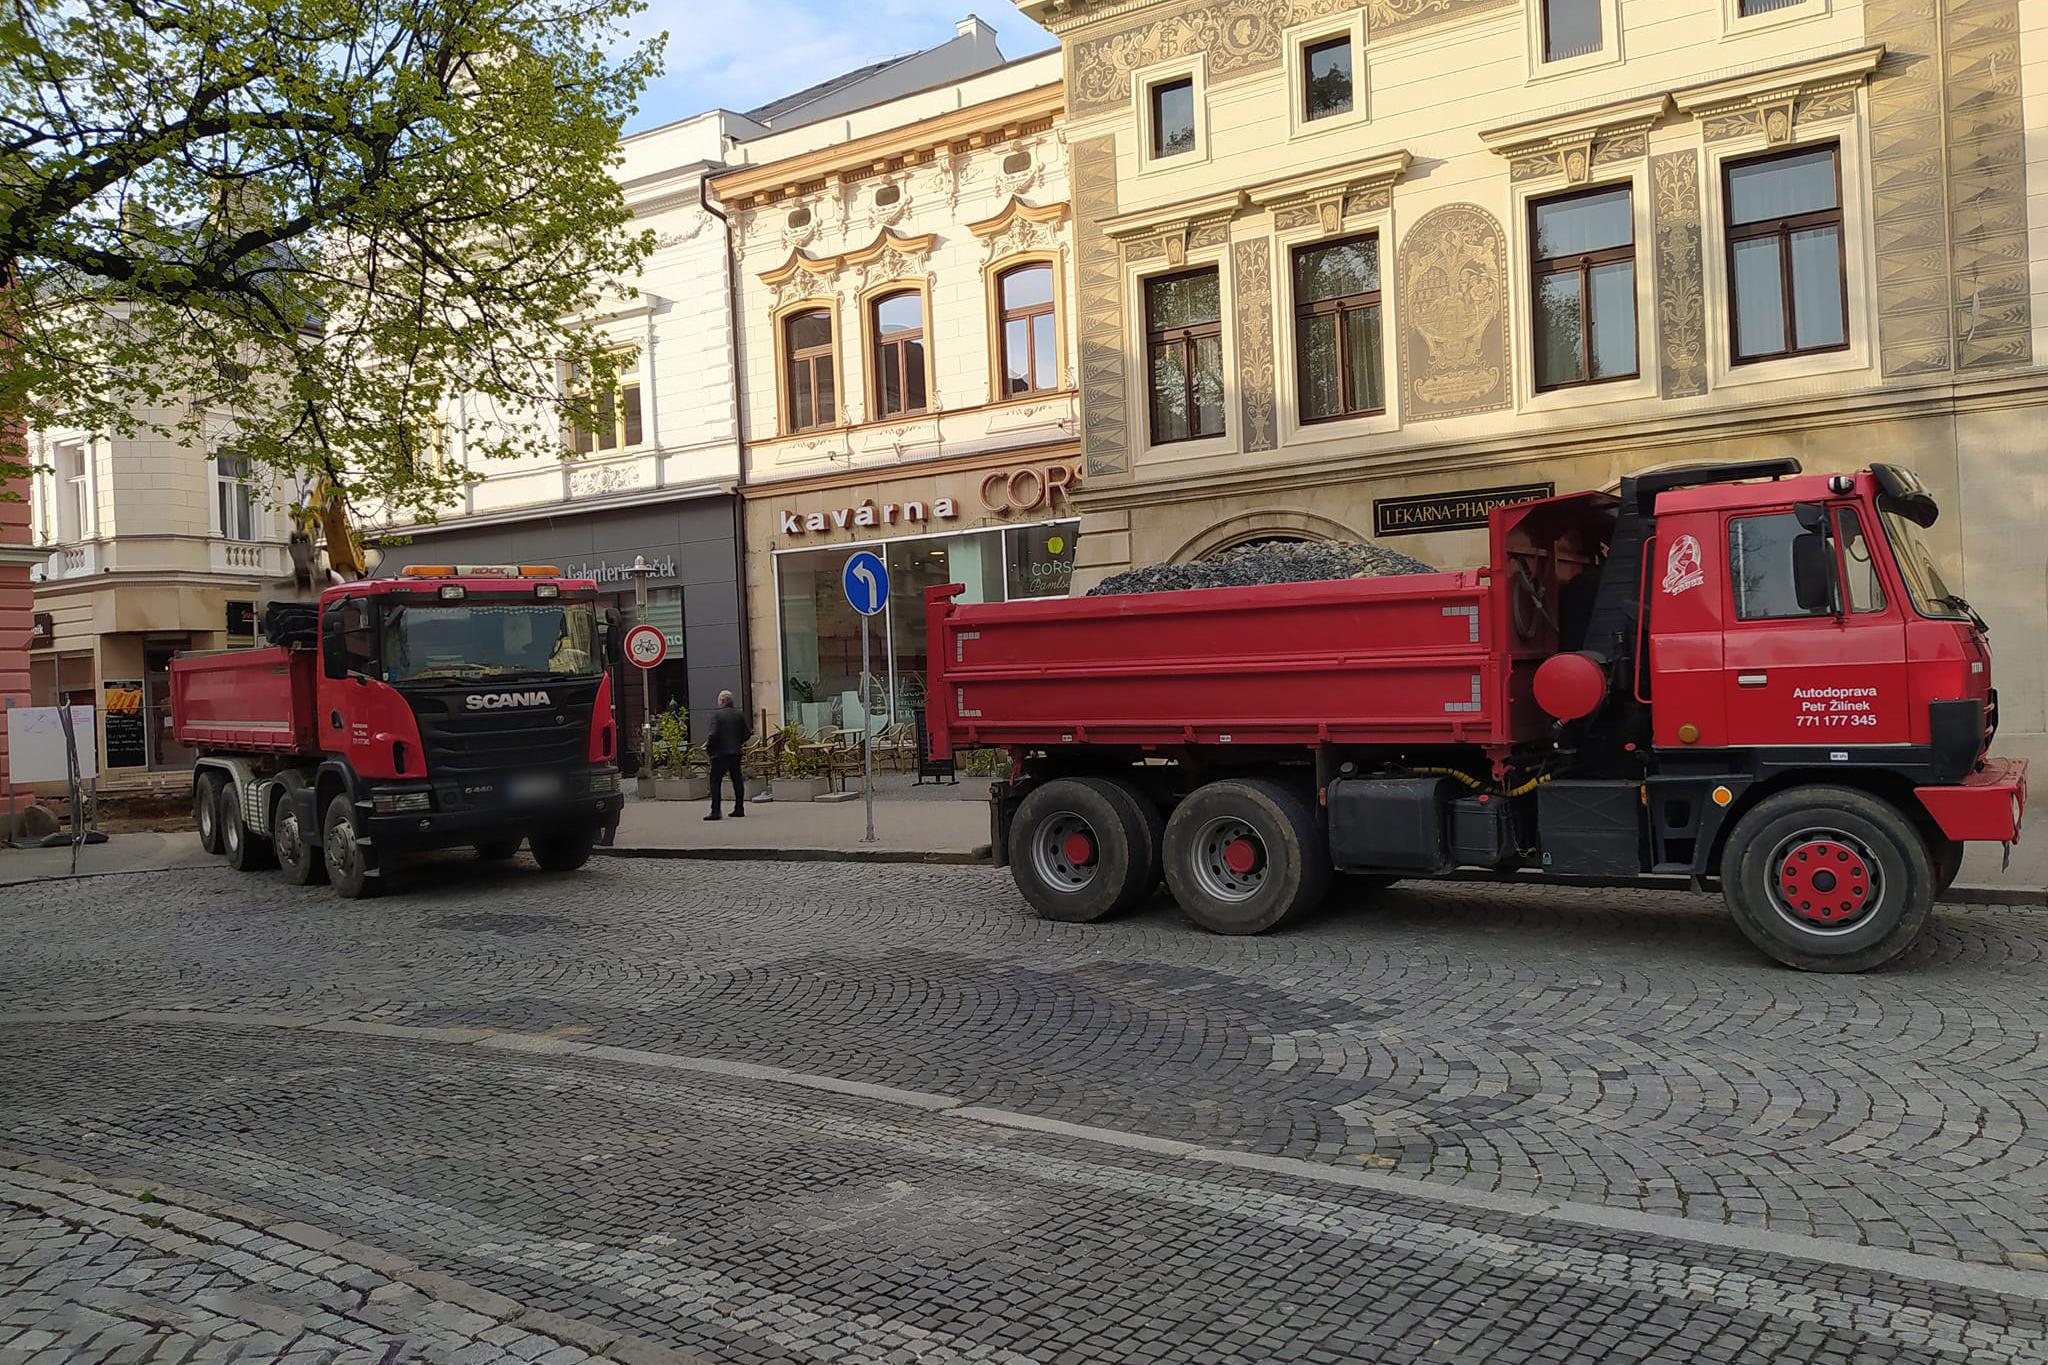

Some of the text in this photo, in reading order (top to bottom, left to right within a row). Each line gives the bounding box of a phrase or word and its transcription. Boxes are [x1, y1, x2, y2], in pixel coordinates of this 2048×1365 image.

[780, 499, 959, 536] kavárna
[1793, 686, 1878, 699] Autodoprava
[465, 691, 551, 710] SCANIA
[1801, 699, 1871, 712] Petr Žilínek
[1796, 713, 1878, 727] 771 177 345
